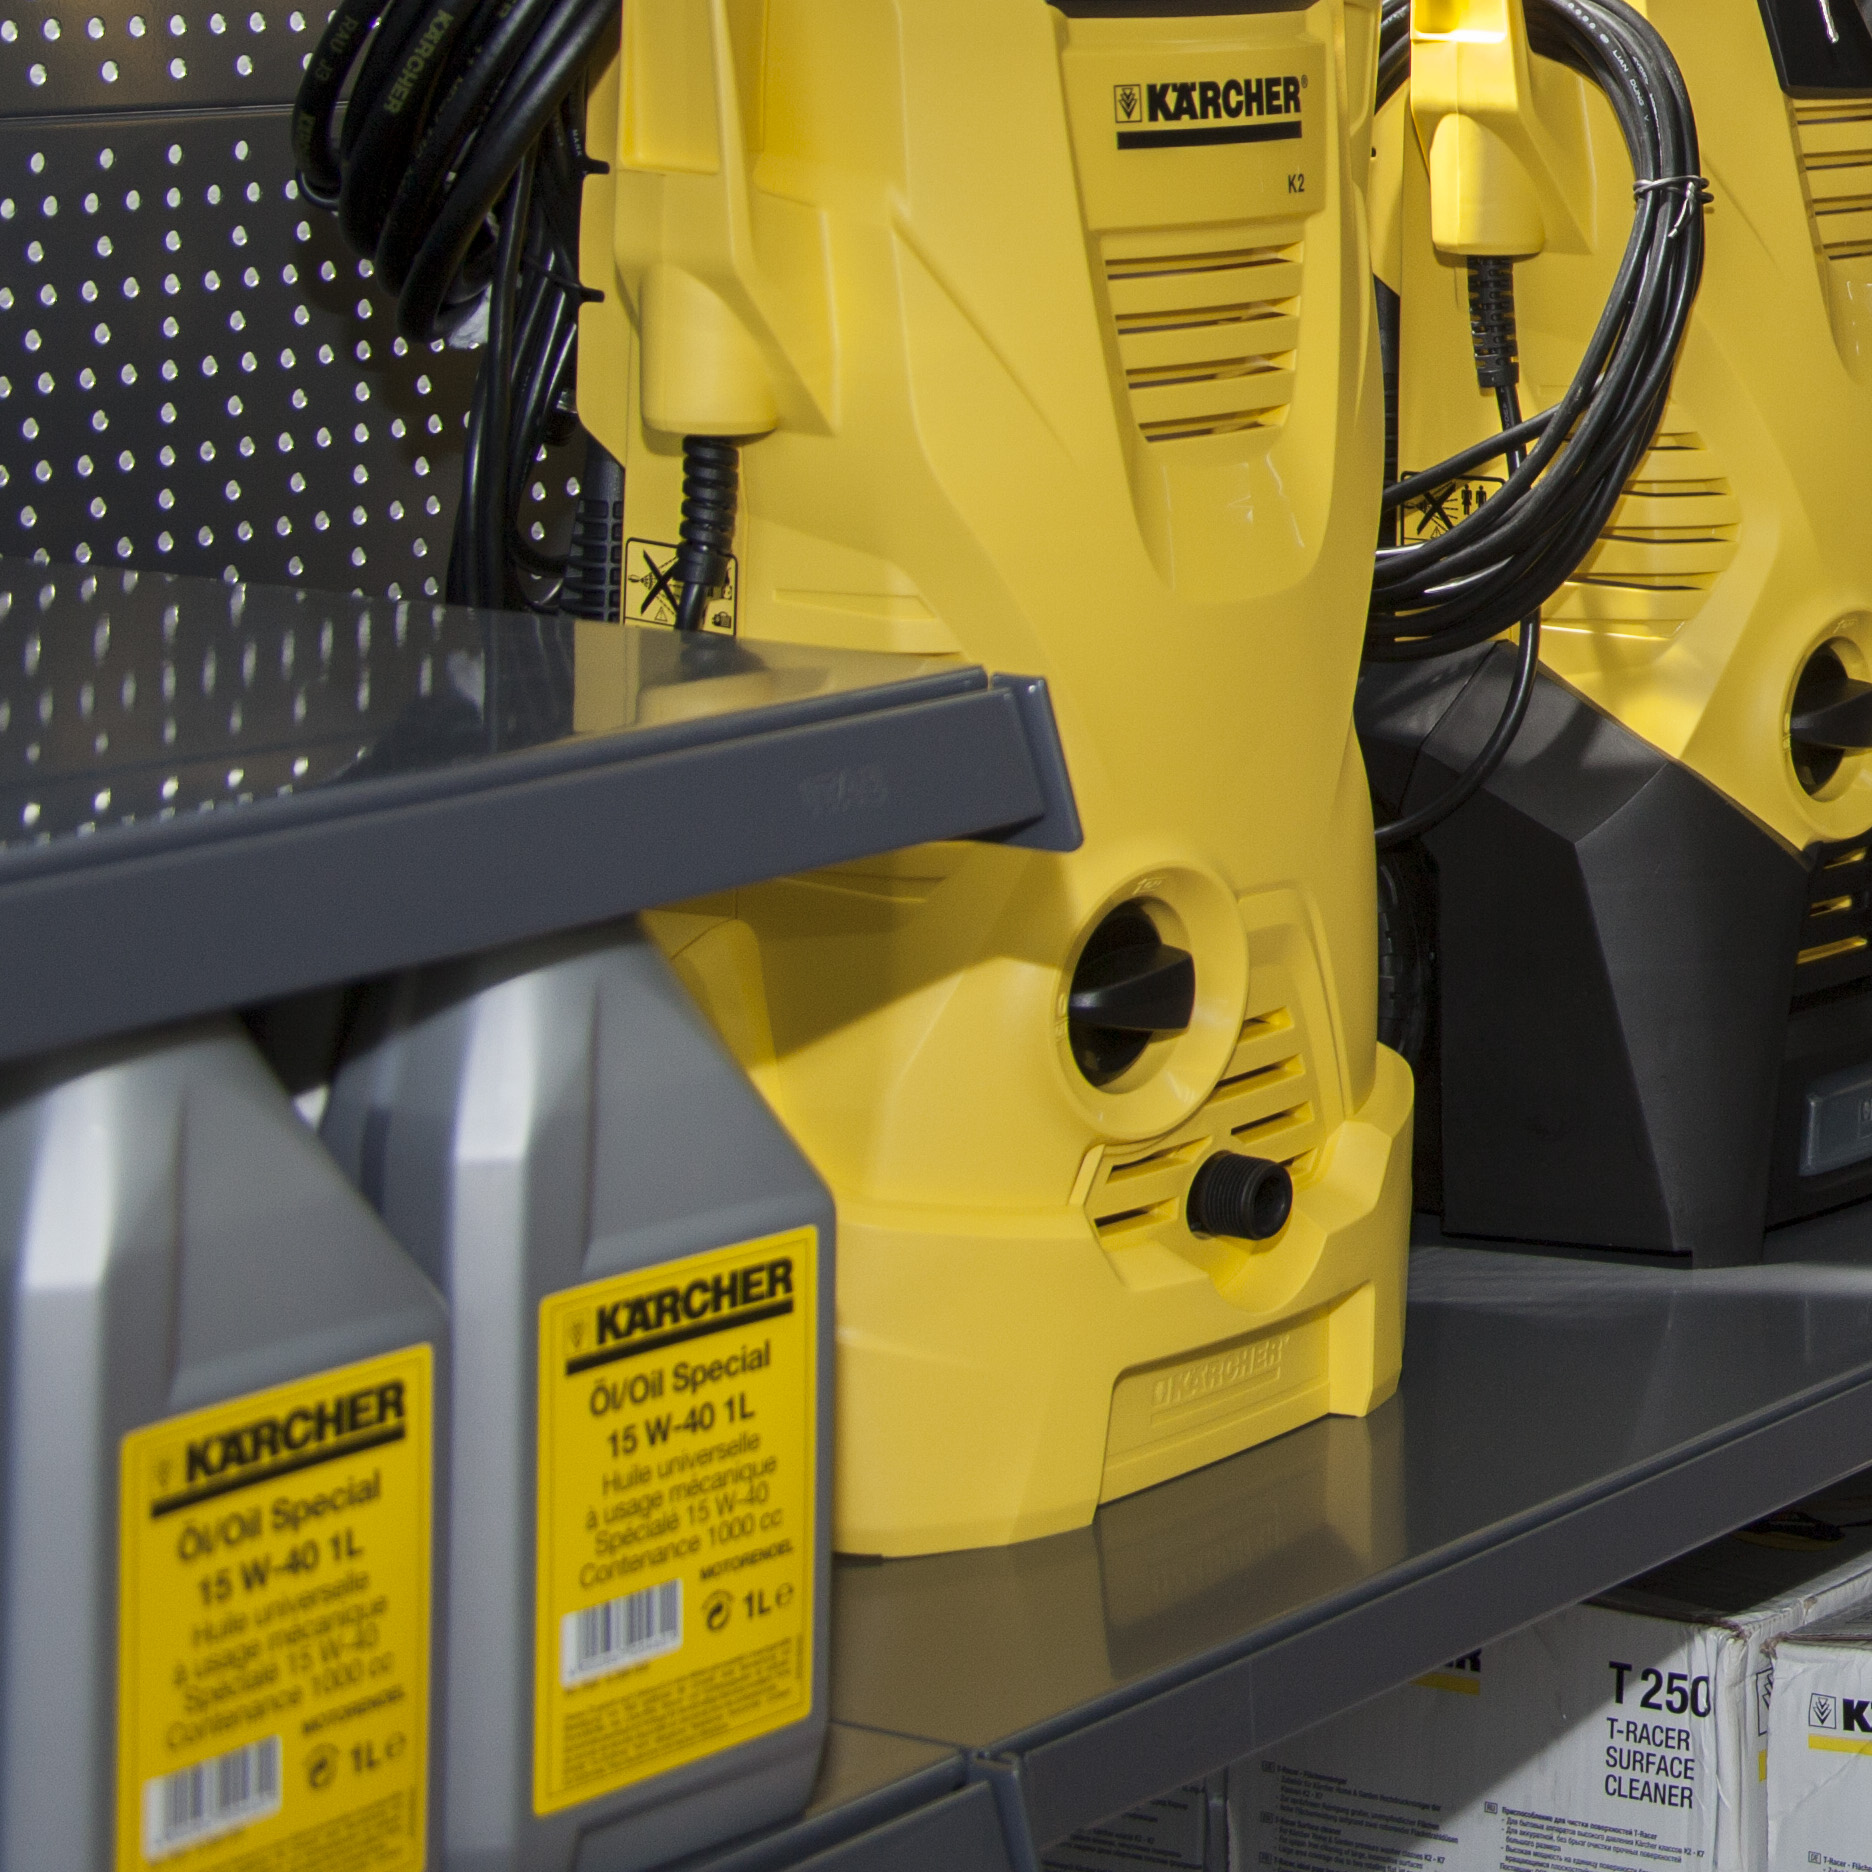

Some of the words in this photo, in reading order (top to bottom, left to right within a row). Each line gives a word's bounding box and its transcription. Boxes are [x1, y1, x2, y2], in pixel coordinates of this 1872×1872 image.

[1147, 76, 1302, 123] KÄRCHER
[1287, 173, 1306, 194] K2
[595, 1256, 794, 1346] KÄRCHER
[672, 1338, 772, 1395] Special
[606, 1424, 639, 1460] 15
[644, 1401, 715, 1449] W-40
[723, 1391, 756, 1424] 1L
[1607, 1660, 1633, 1706] T
[1638, 1666, 1713, 1718] 250
[1605, 1716, 1693, 1754] T-RACER
[1604, 1744, 1697, 1783] SURFACE
[1603, 1774, 1696, 1811] CLEANER
